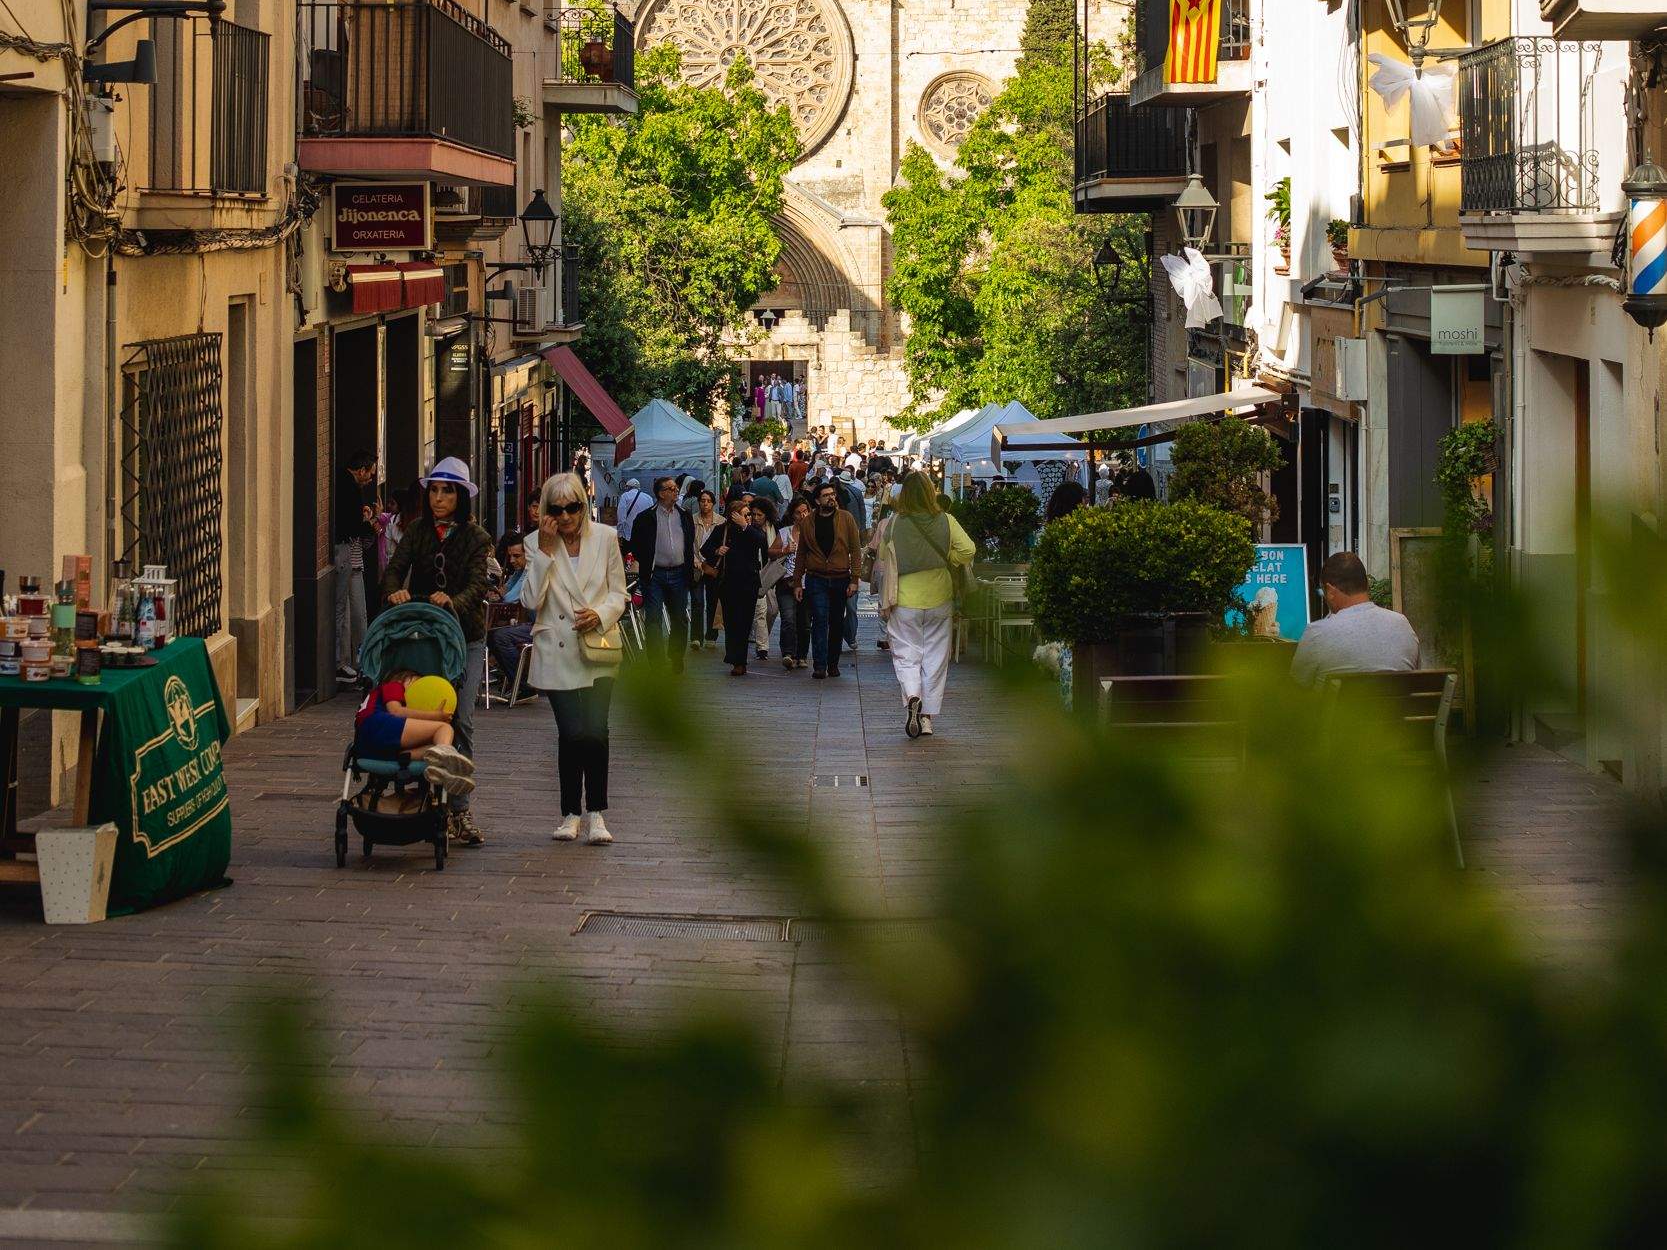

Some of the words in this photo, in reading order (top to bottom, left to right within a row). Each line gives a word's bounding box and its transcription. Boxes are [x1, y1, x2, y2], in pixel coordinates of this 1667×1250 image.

[338, 207, 421, 224] Jijonenca
[352, 230, 406, 240] ORXATERIA
[1438, 327, 1478, 340] moshi
[1256, 573, 1288, 584] HERE
[142, 773, 177, 815] EAST
[174, 756, 202, 793] WEST
